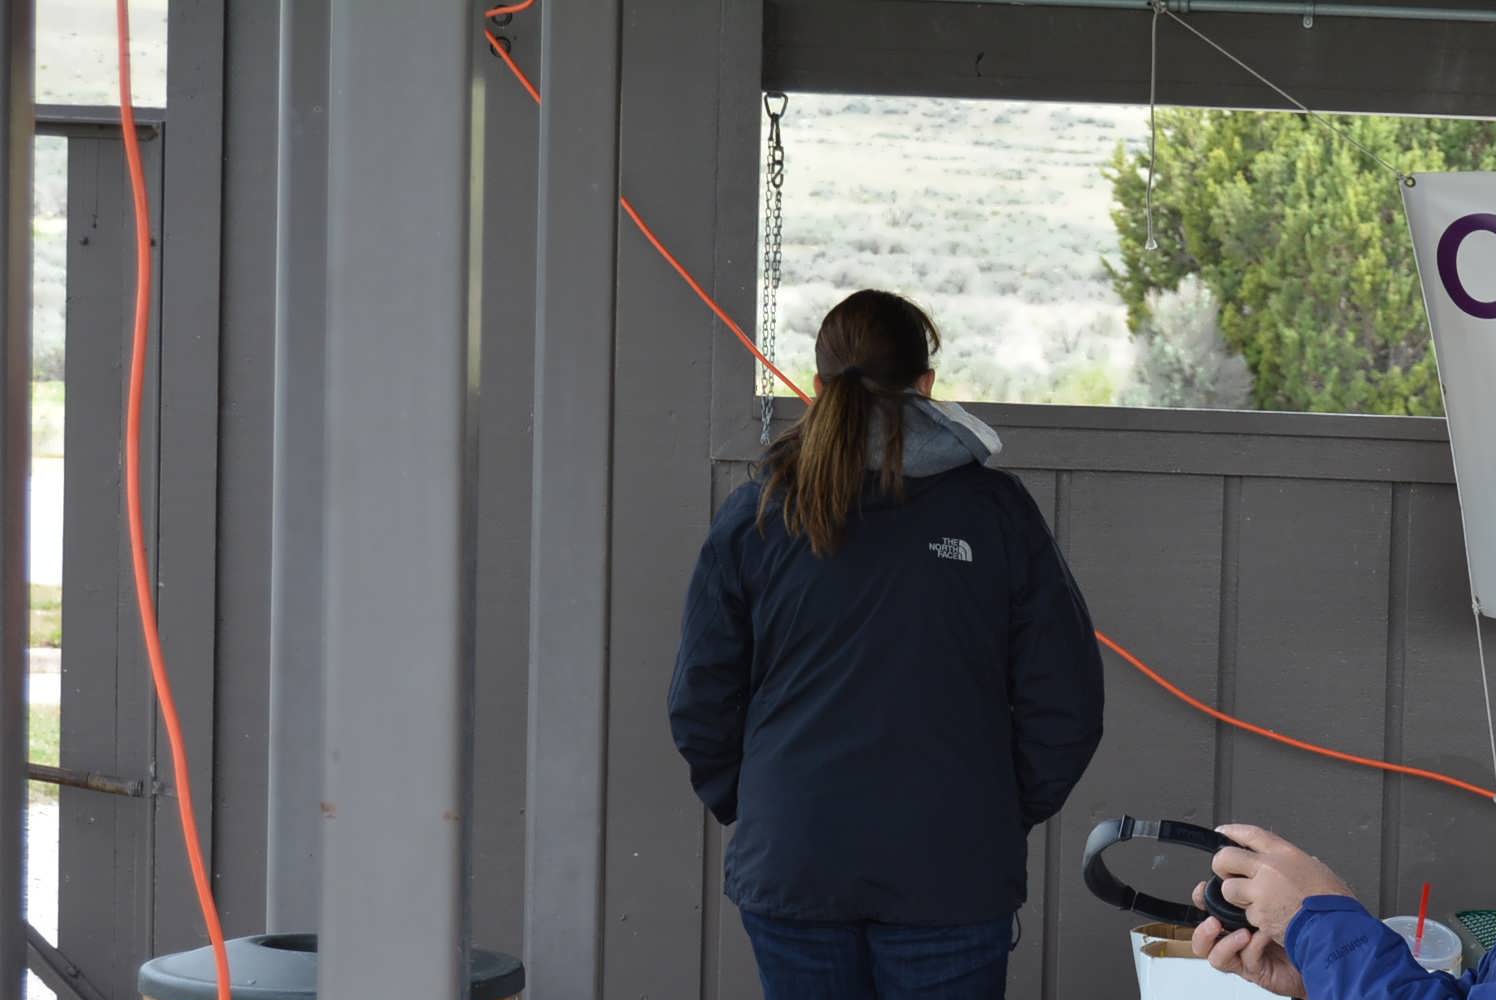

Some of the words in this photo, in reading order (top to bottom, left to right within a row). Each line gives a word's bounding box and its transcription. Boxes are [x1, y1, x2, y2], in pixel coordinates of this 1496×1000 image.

[942, 537, 959, 545] THE
[928, 542, 959, 552] NORTH
[937, 550, 959, 560] FACE
